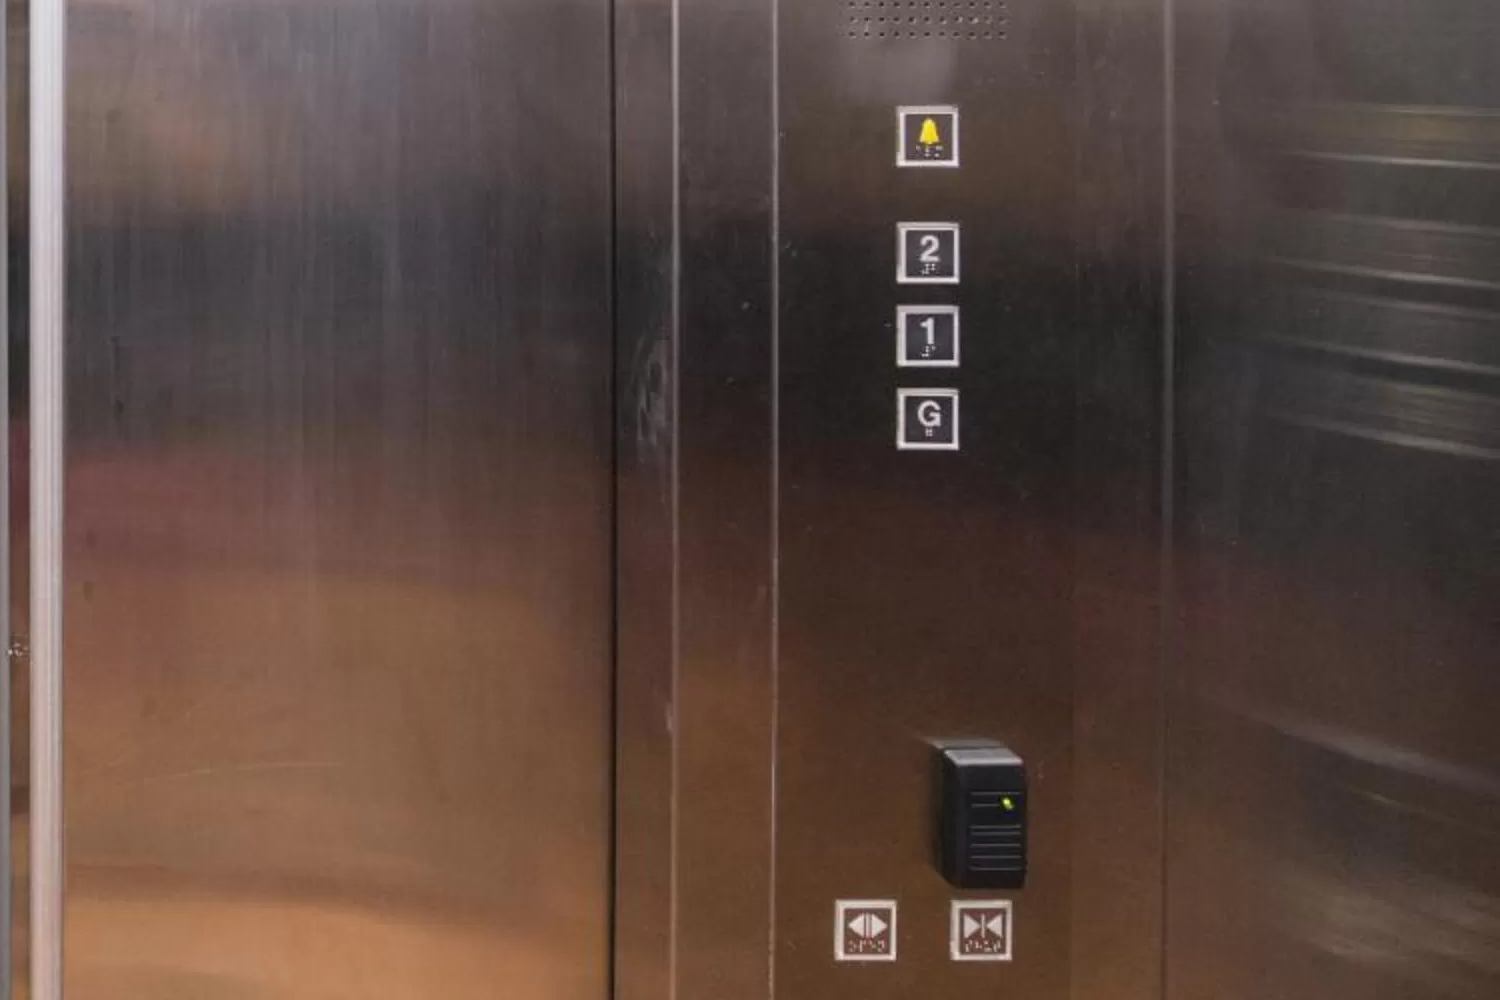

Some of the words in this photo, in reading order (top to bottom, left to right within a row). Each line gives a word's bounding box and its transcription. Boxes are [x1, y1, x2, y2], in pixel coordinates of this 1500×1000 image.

[920, 235, 940, 263] 2
[920, 317, 935, 344] 1
[917, 400, 941, 427] G
